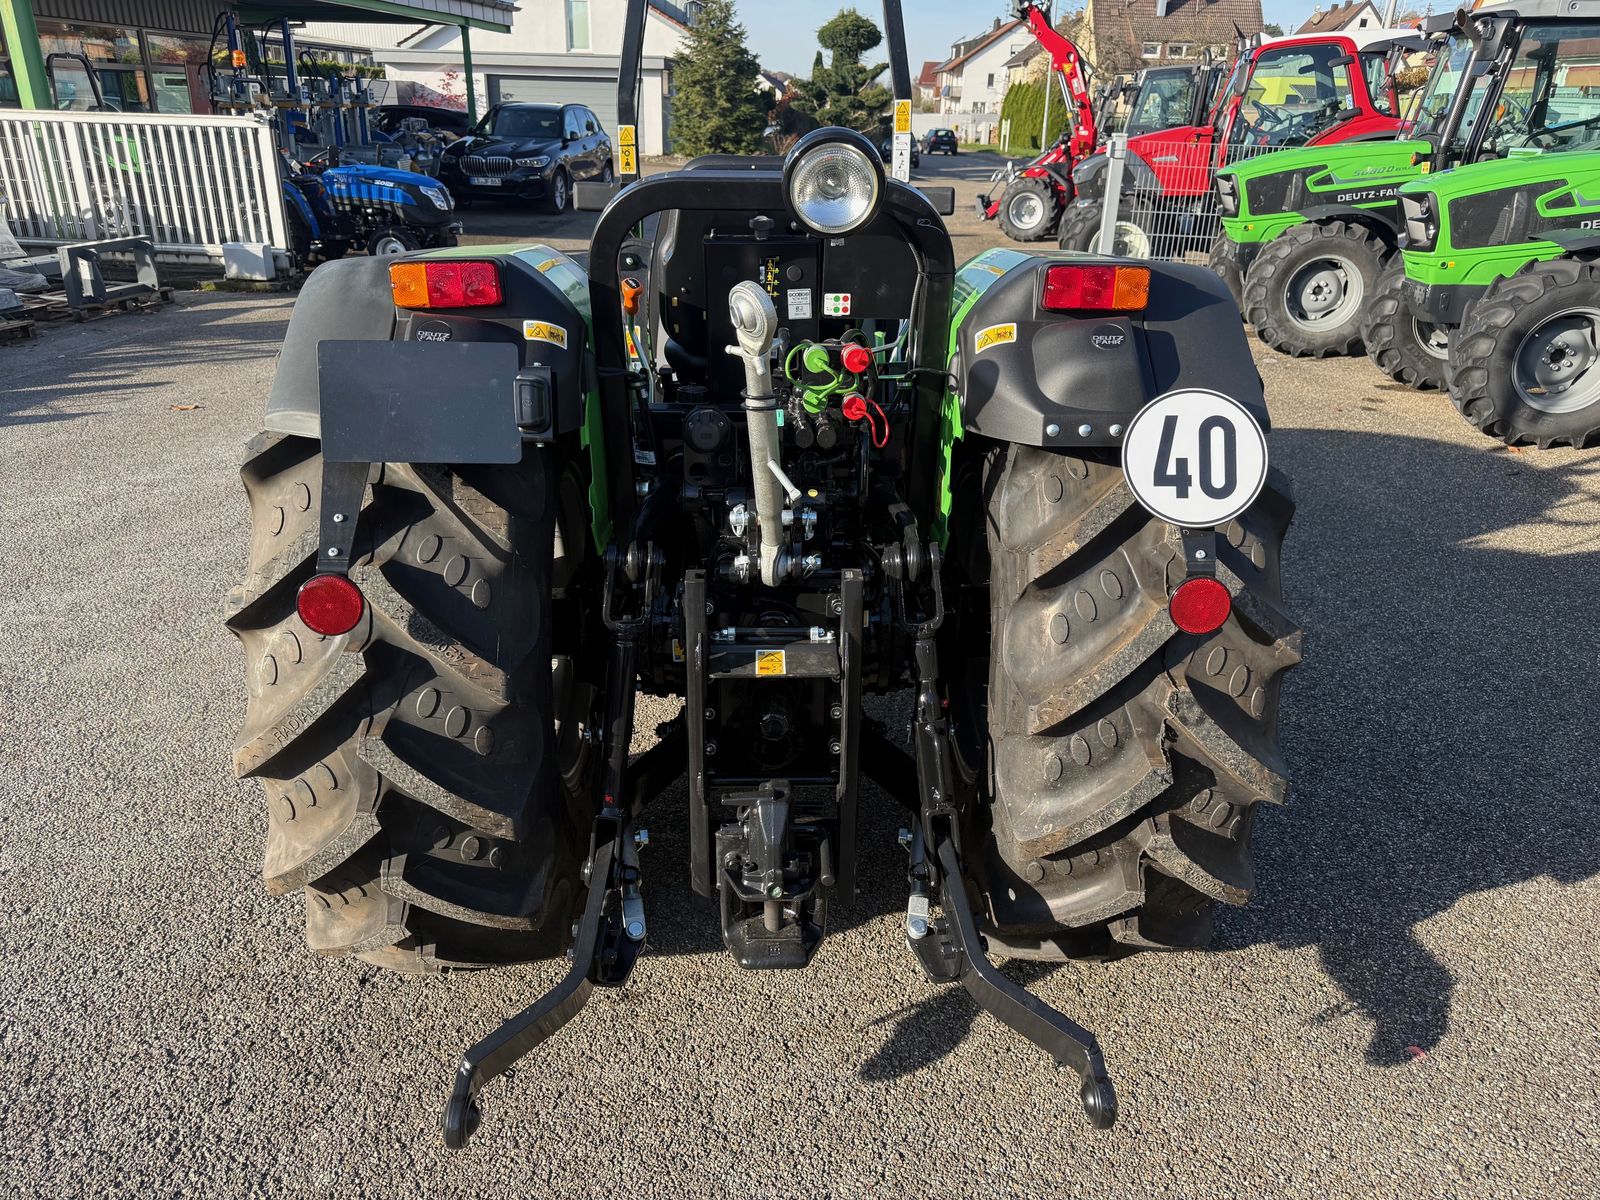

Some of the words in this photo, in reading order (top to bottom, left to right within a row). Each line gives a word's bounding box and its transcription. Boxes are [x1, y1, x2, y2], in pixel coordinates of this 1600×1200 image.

[1337, 189, 1396, 202] DEUTZ-FA
[417, 330, 451, 339] DEUTZ
[1153, 414, 1238, 500] 40
[273, 705, 319, 744] RADIAL
